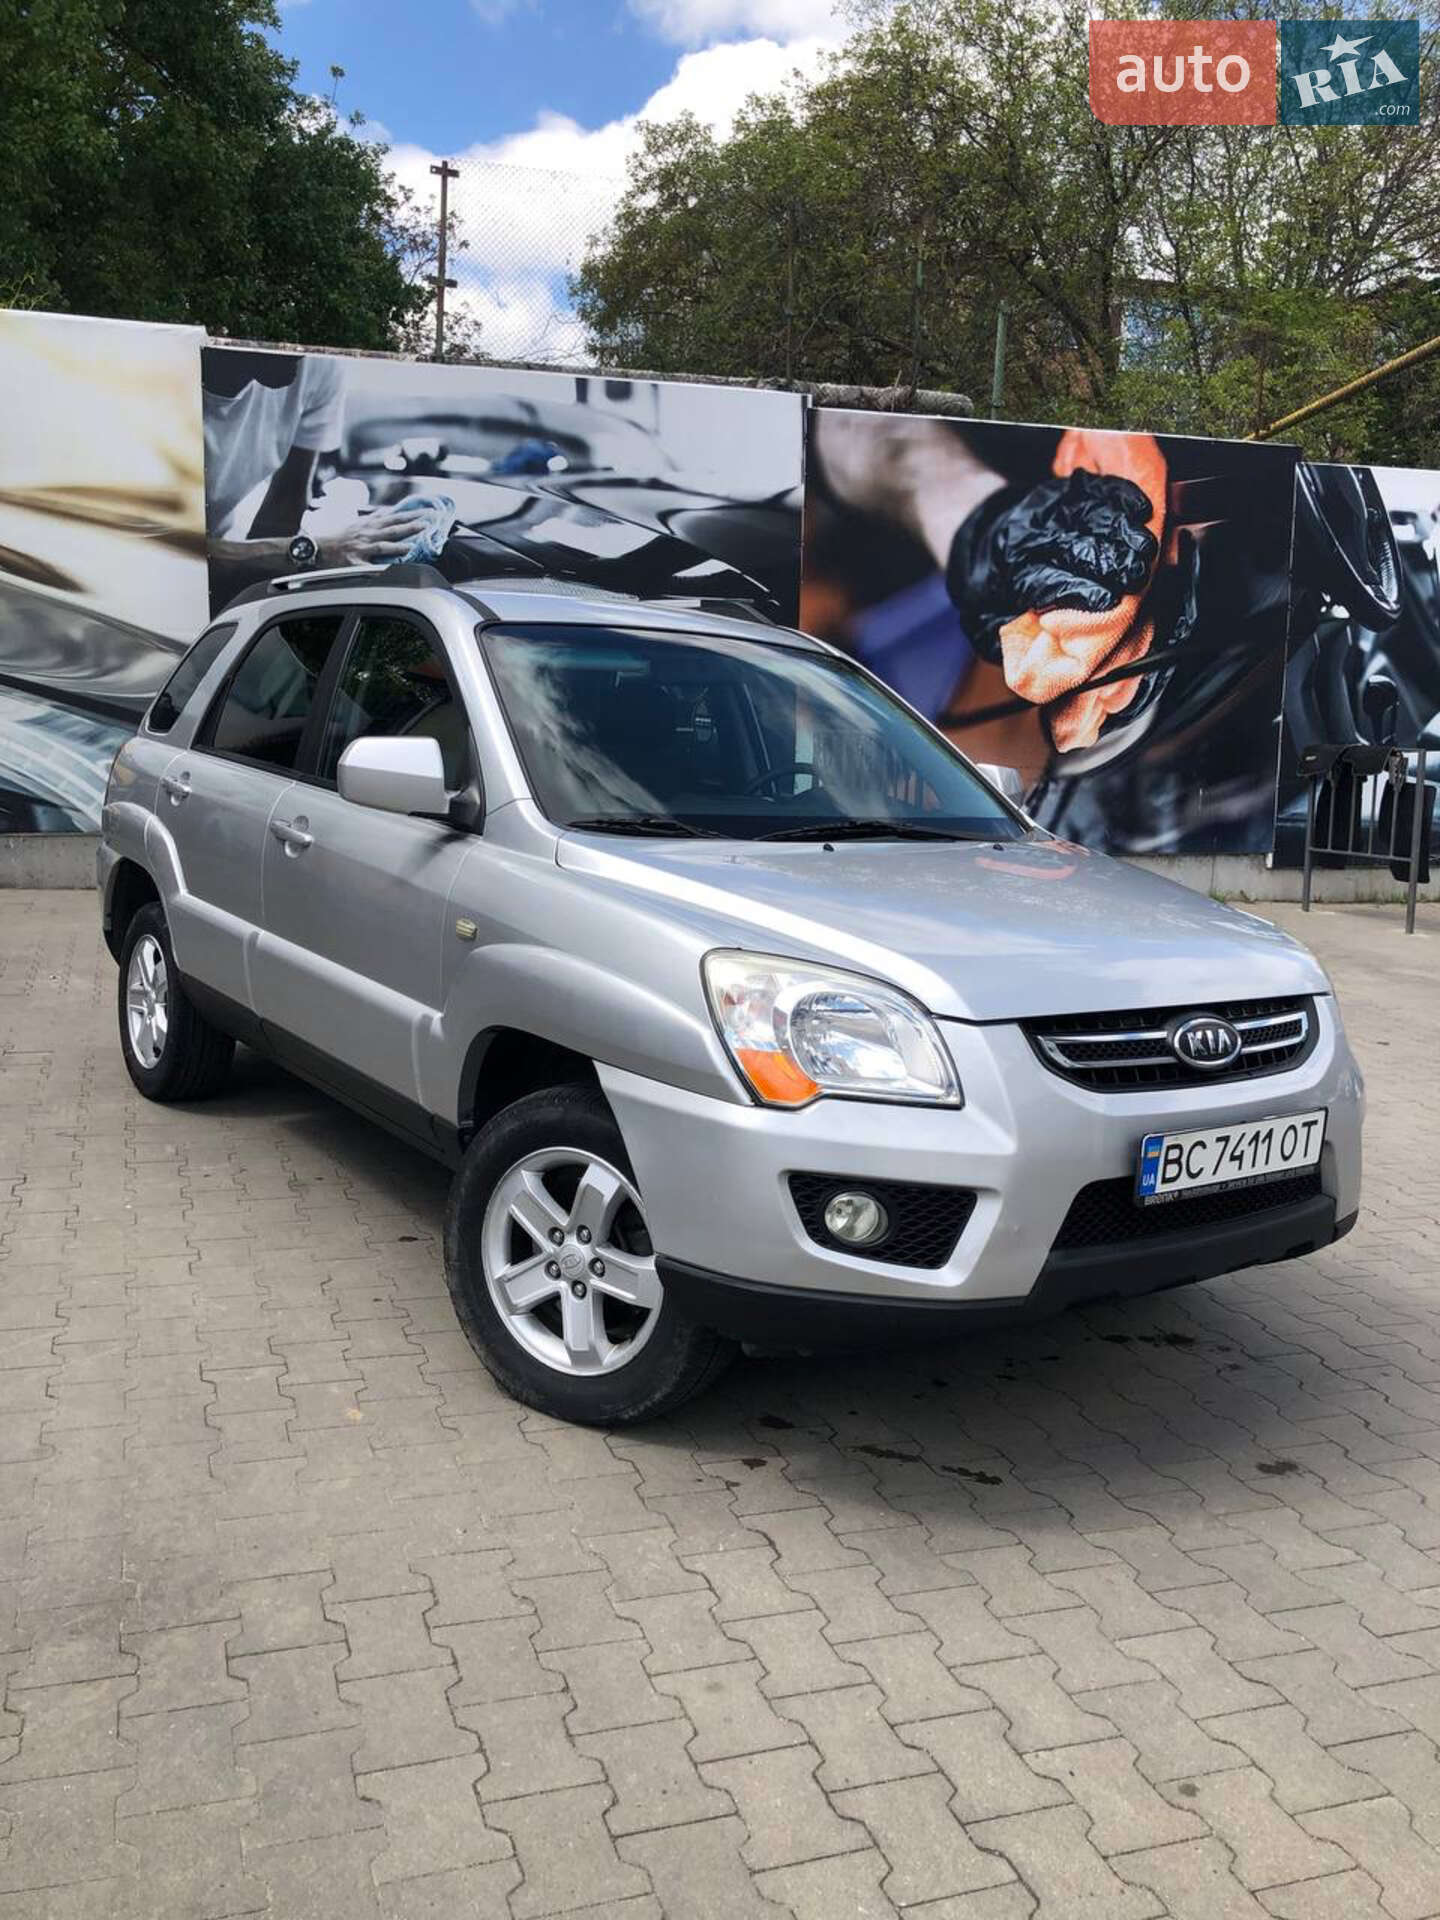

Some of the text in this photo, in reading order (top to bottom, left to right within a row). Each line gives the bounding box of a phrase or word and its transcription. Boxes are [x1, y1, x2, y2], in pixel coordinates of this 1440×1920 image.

[1186, 1028, 1233, 1057] KIA
[1161, 1119, 1319, 1185] BC 7411 OT
[1142, 1174, 1156, 1187] UA
